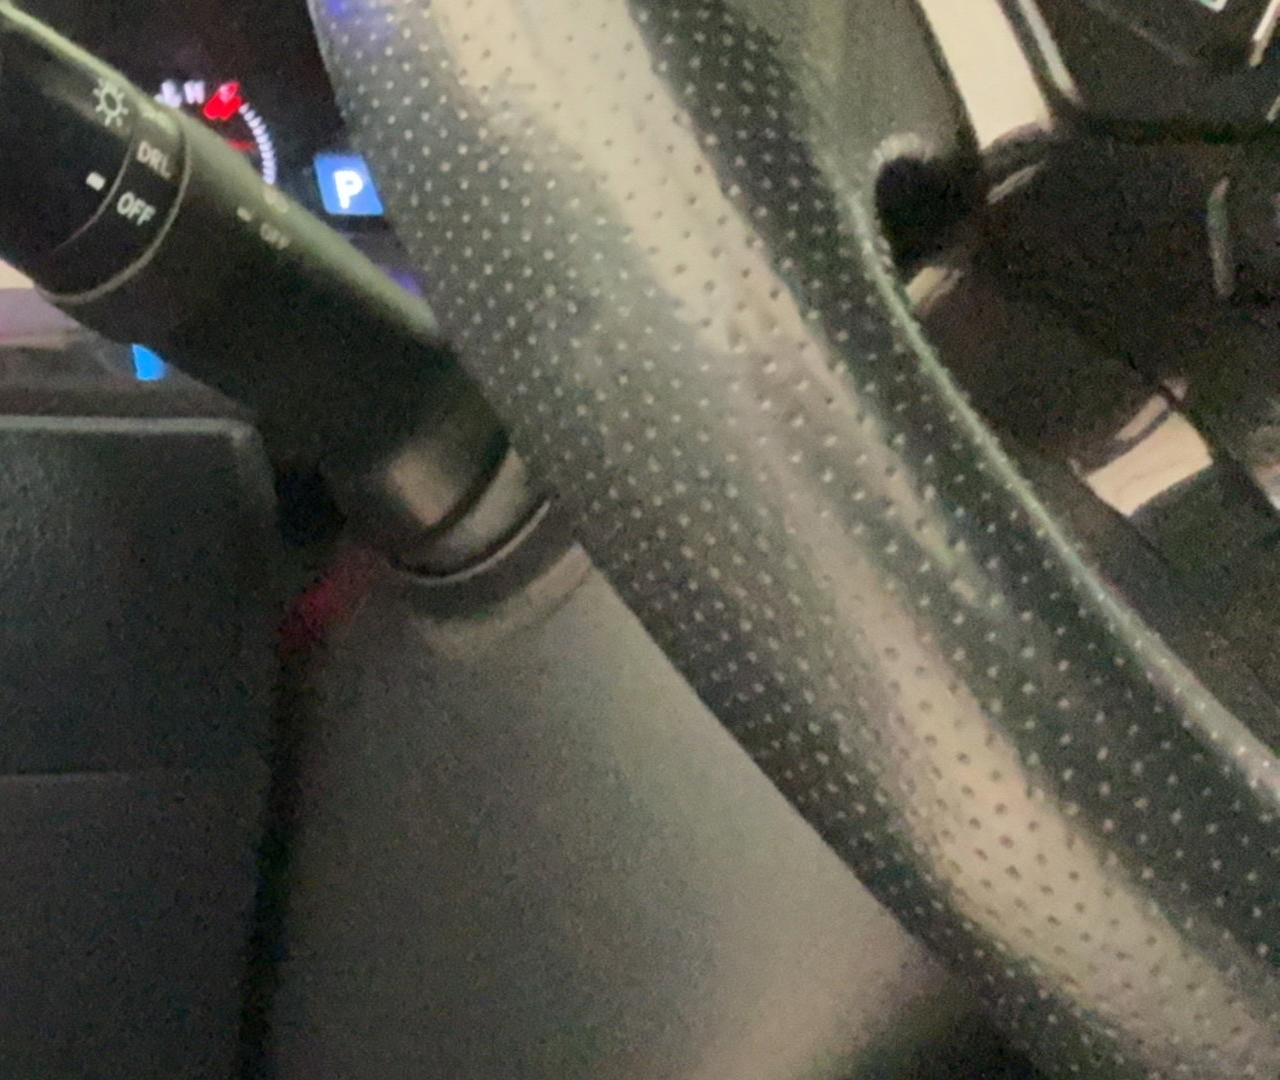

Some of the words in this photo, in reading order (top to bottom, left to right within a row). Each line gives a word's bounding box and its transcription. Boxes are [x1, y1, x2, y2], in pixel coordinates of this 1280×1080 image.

[135, 140, 172, 181] DRL
[116, 191, 157, 227] OFF
[333, 169, 364, 209] P
